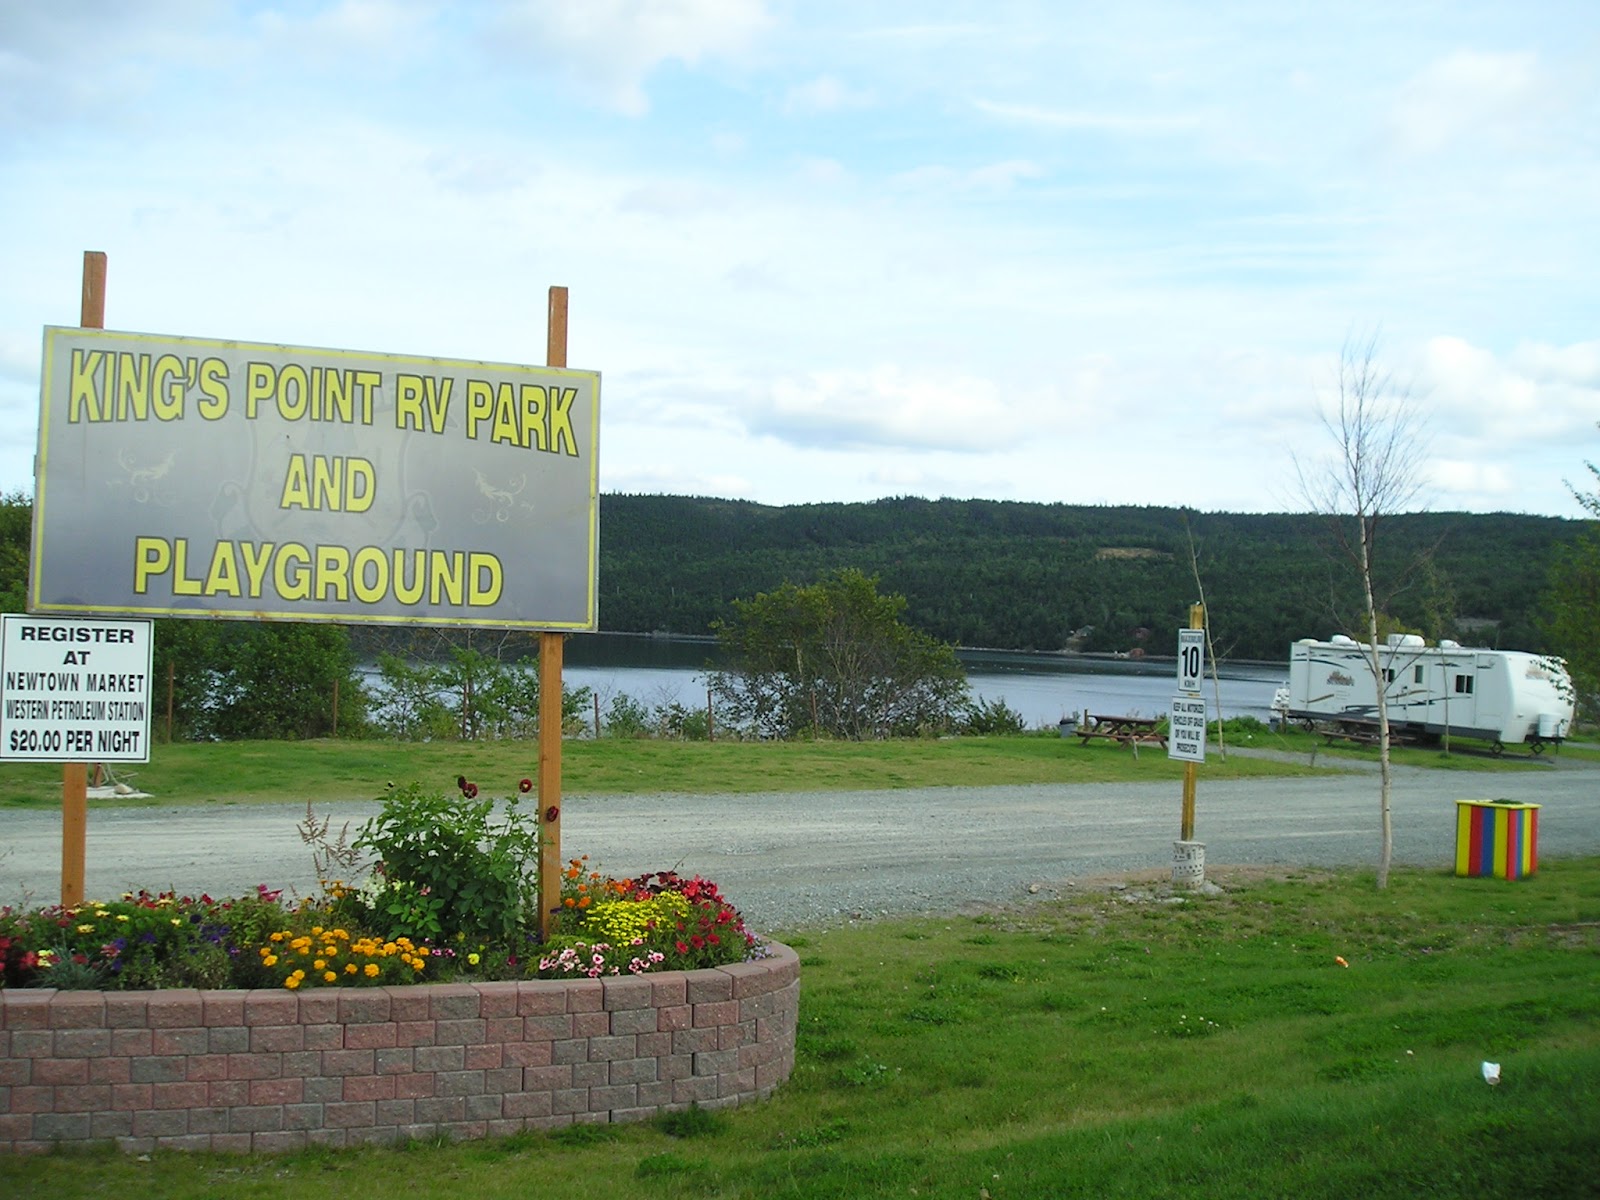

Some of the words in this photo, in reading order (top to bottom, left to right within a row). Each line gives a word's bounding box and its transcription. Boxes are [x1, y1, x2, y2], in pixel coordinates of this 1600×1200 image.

[67, 347, 230, 425] KING'S
[246, 361, 382, 425] POINT
[395, 373, 455, 434] RV
[466, 379, 580, 458] PARK
[279, 454, 376, 513] AND
[133, 536, 504, 607] PLAYGROUND
[21, 626, 134, 643] REGISTER
[63, 651, 91, 665] AT
[1182, 646, 1199, 678] 10
[6, 672, 79, 692] NEWTOWN
[86, 673, 144, 693] MARKET
[6, 699, 49, 719] WESTERN
[52, 700, 105, 720] PETROLEUM
[108, 701, 144, 721] STATION
[10, 728, 61, 752] $20.00
[66, 730, 93, 752] PER
[98, 730, 140, 753] NIGHT
